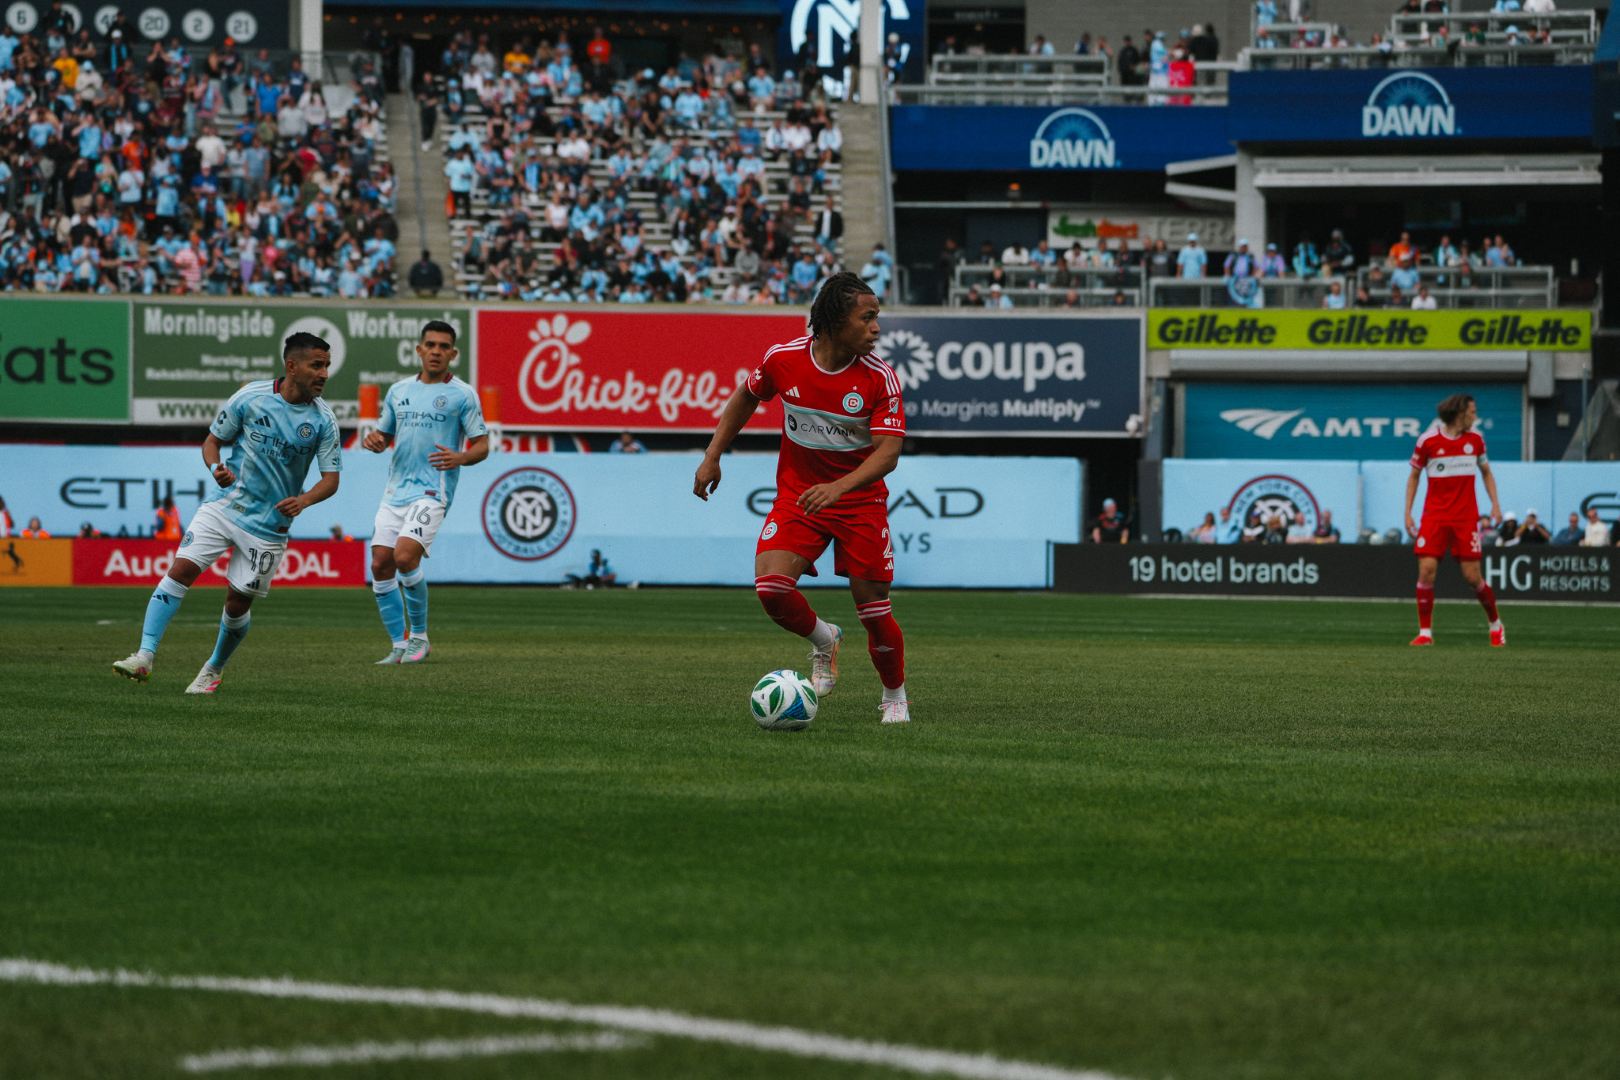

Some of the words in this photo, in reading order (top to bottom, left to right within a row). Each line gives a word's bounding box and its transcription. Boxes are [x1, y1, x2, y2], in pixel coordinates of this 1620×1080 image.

[145, 16, 164, 31] 20
[193, 18, 204, 32] 2
[232, 19, 250, 34] 21
[1362, 104, 1455, 136] DAWN
[1030, 138, 1115, 168] DAWN
[144, 307, 275, 342] Morningside
[1158, 313, 1277, 345] Gillette
[1307, 314, 1428, 346] Gillette
[1459, 315, 1581, 346] Gillette
[0, 337, 115, 386] ats
[936, 341, 1086, 392] coupa
[397, 411, 446, 423] ETIHAD
[921, 400, 999, 422] Margins
[250, 431, 312, 456] ETIHAD
[59, 476, 206, 510] ETIH
[409, 505, 431, 526] 16
[104, 548, 178, 577] Aud
[248, 547, 275, 575] 10
[1129, 555, 1156, 582] 19
[1161, 555, 1223, 583] hotel
[1229, 556, 1319, 584] brands
[1485, 555, 1532, 592] HG
[1540, 555, 1598, 572] HOTELS
[1540, 575, 1611, 592] RESORTS
